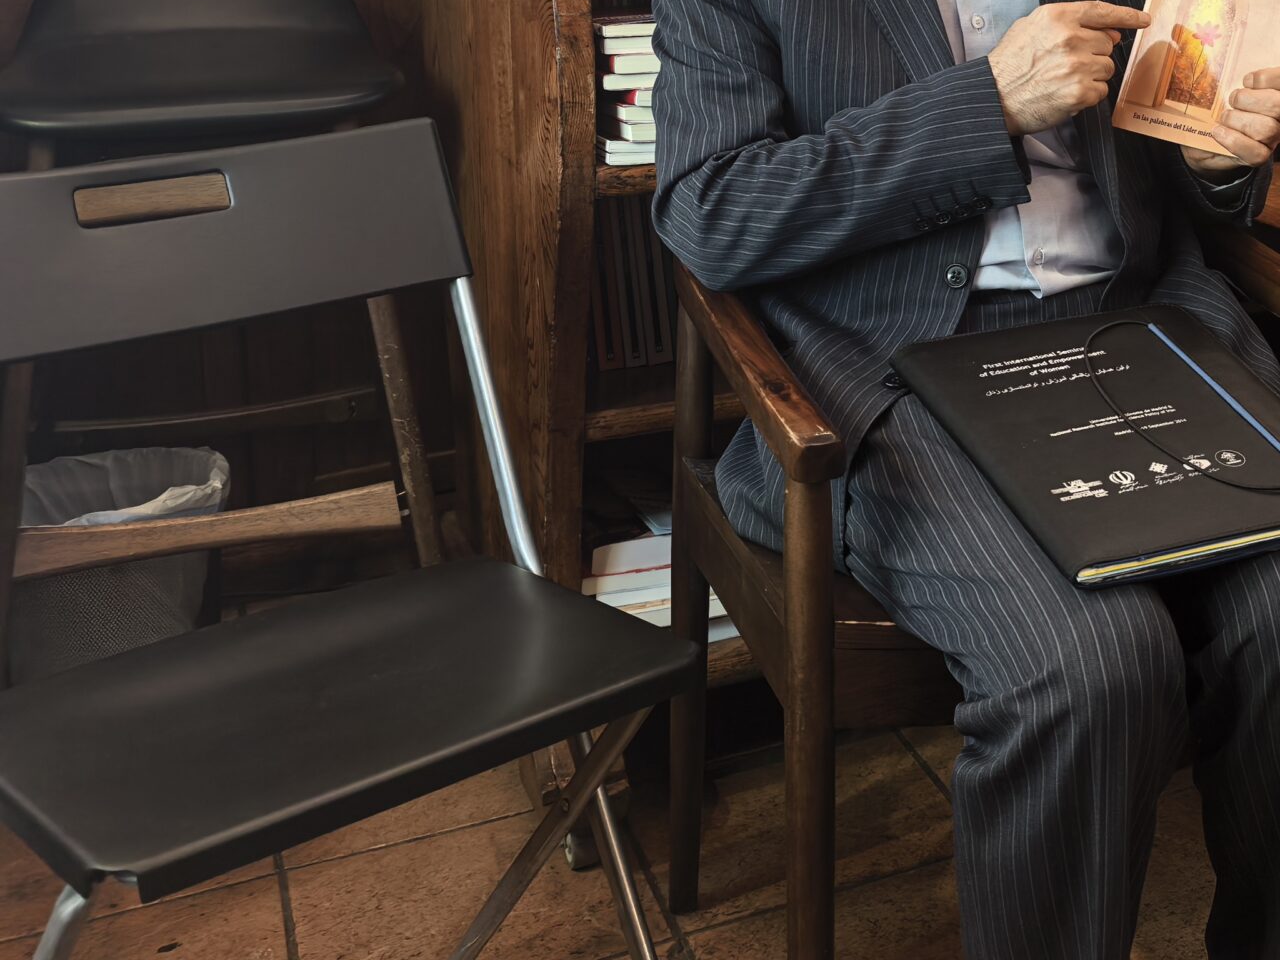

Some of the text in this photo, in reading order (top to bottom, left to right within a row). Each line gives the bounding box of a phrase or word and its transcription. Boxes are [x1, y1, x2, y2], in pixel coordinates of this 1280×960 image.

[1133, 112, 1197, 135] En las palabras del Líder
[983, 346, 1085, 369] First International Semina
[979, 370, 988, 378] of
[991, 365, 1031, 377] Education
[1032, 361, 1047, 370] and
[1041, 365, 1070, 375] Women
